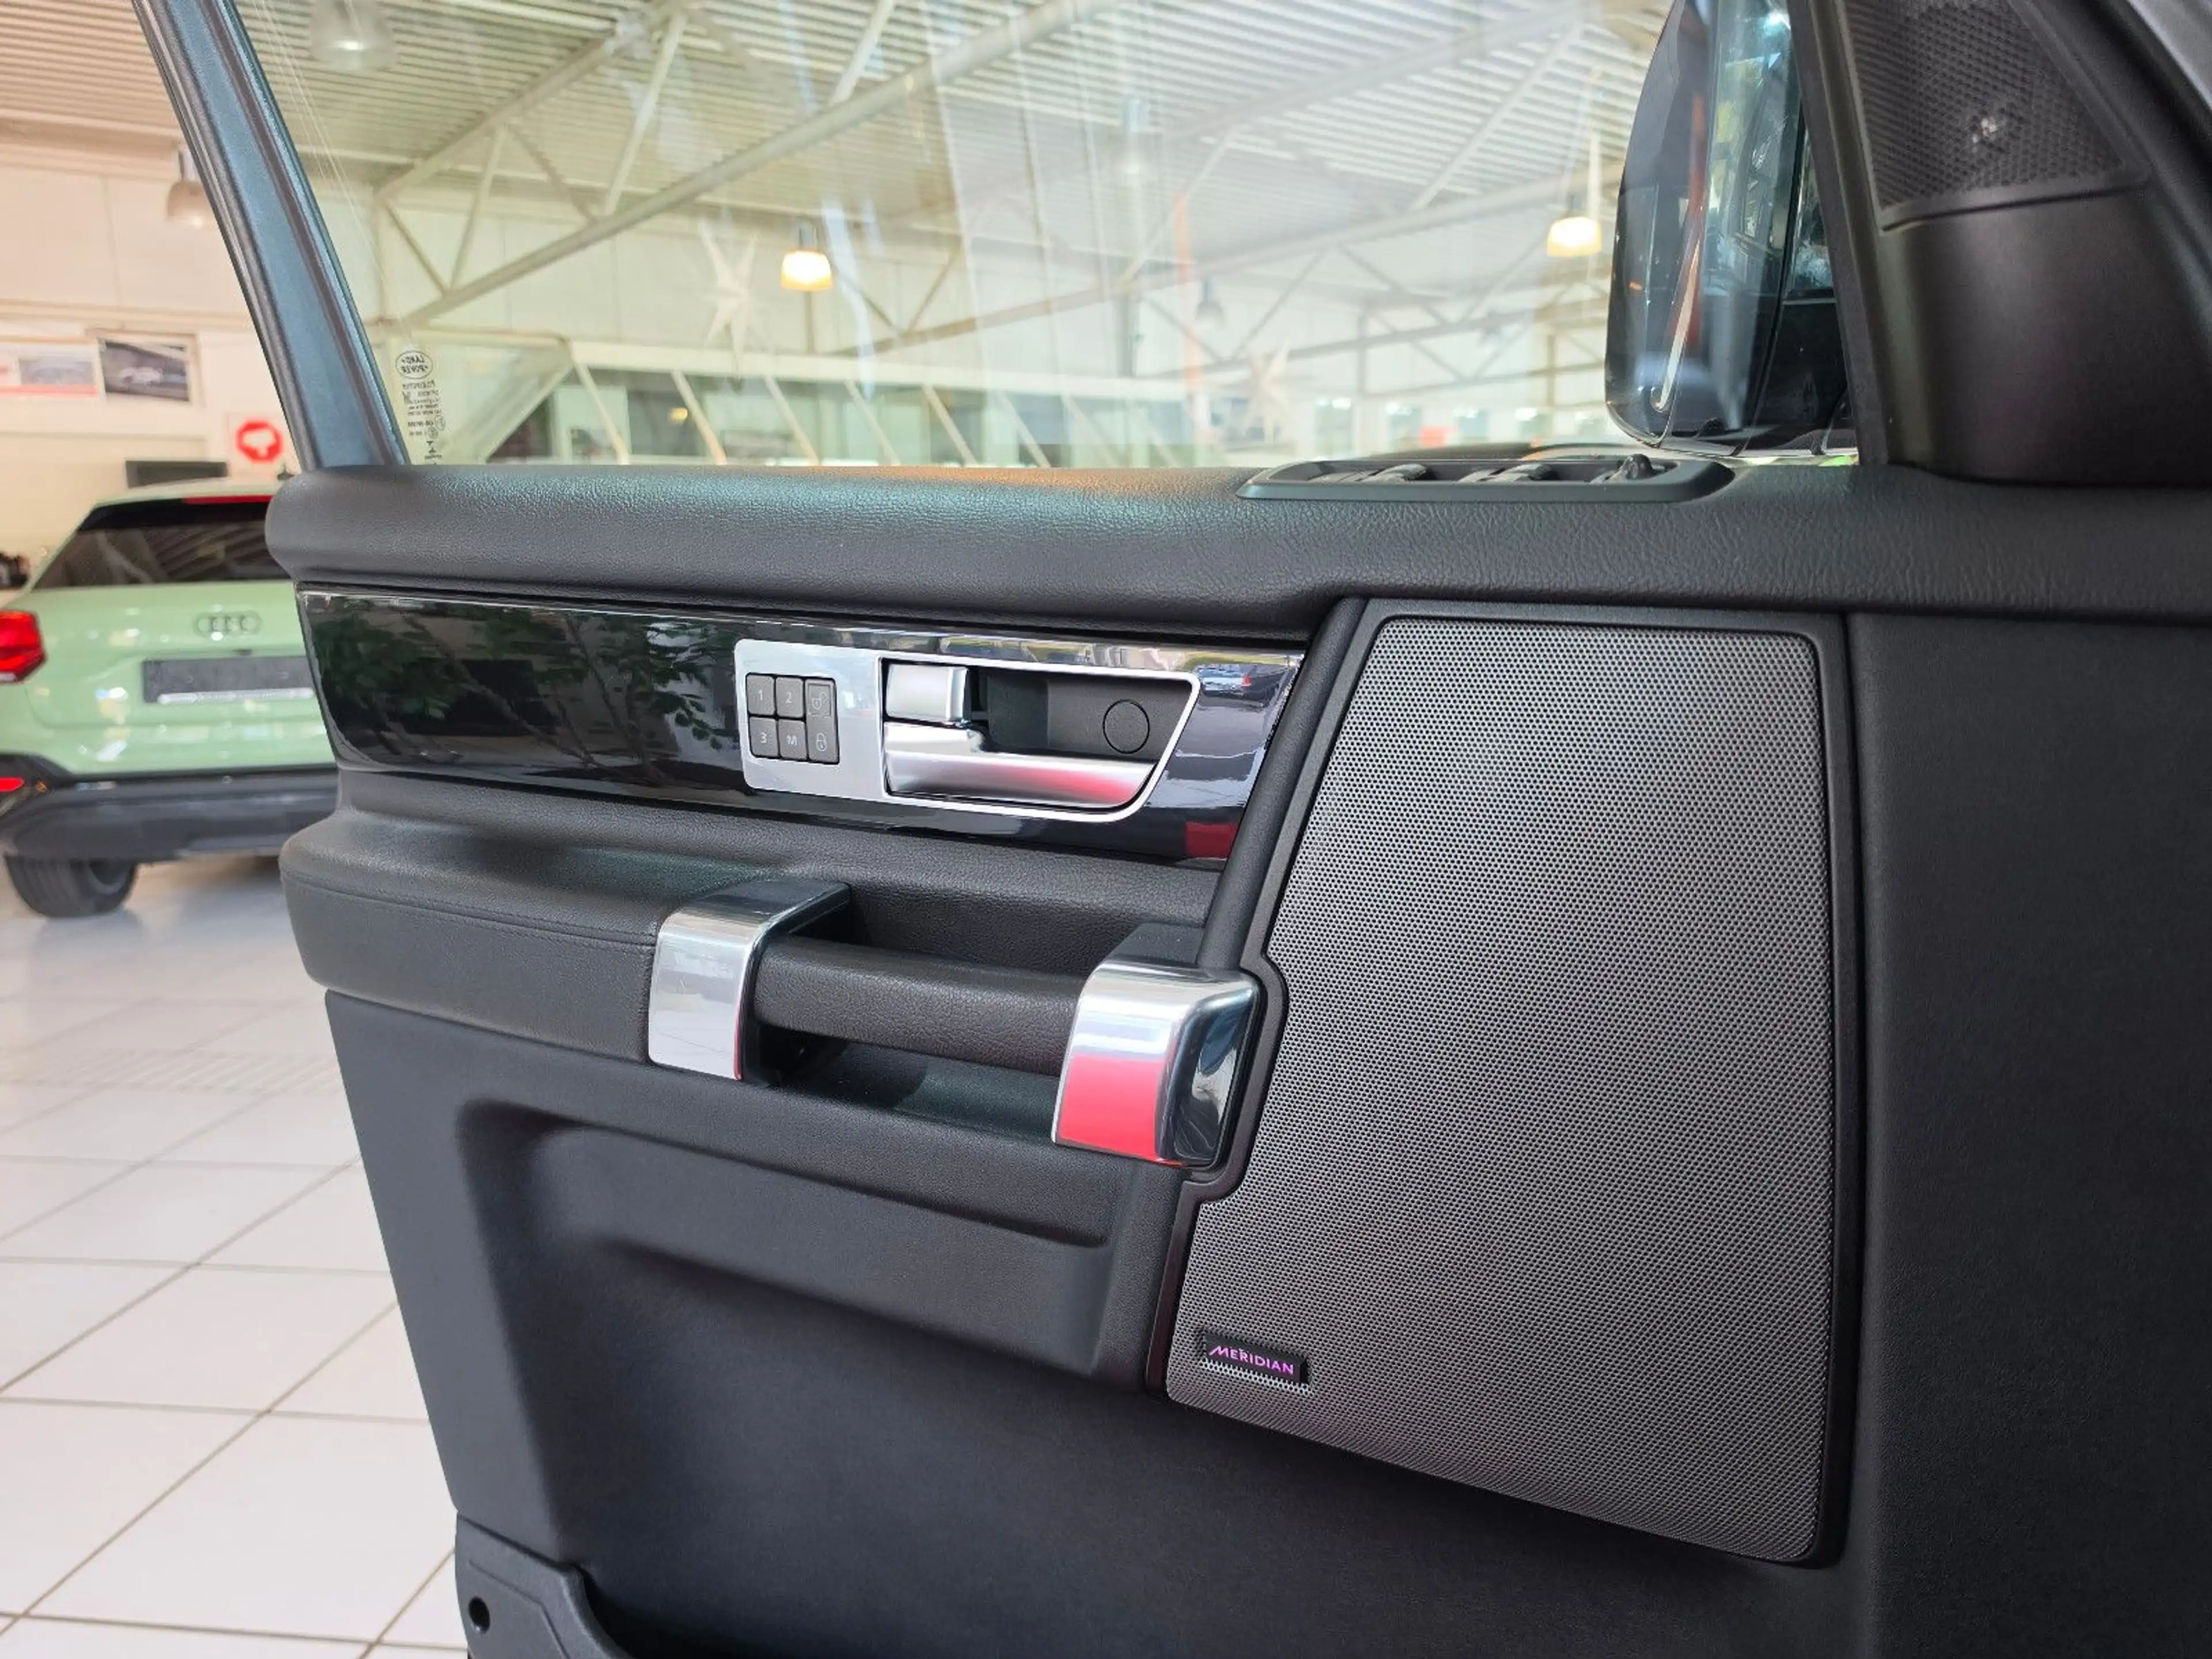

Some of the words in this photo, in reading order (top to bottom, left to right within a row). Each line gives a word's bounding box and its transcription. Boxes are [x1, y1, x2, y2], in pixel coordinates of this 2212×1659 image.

[757, 690, 763, 700] 1
[785, 692, 793, 703] 2
[760, 733, 767, 744] 3
[786, 735, 797, 746] M
[1209, 1345, 1294, 1375] MERIDIAN
